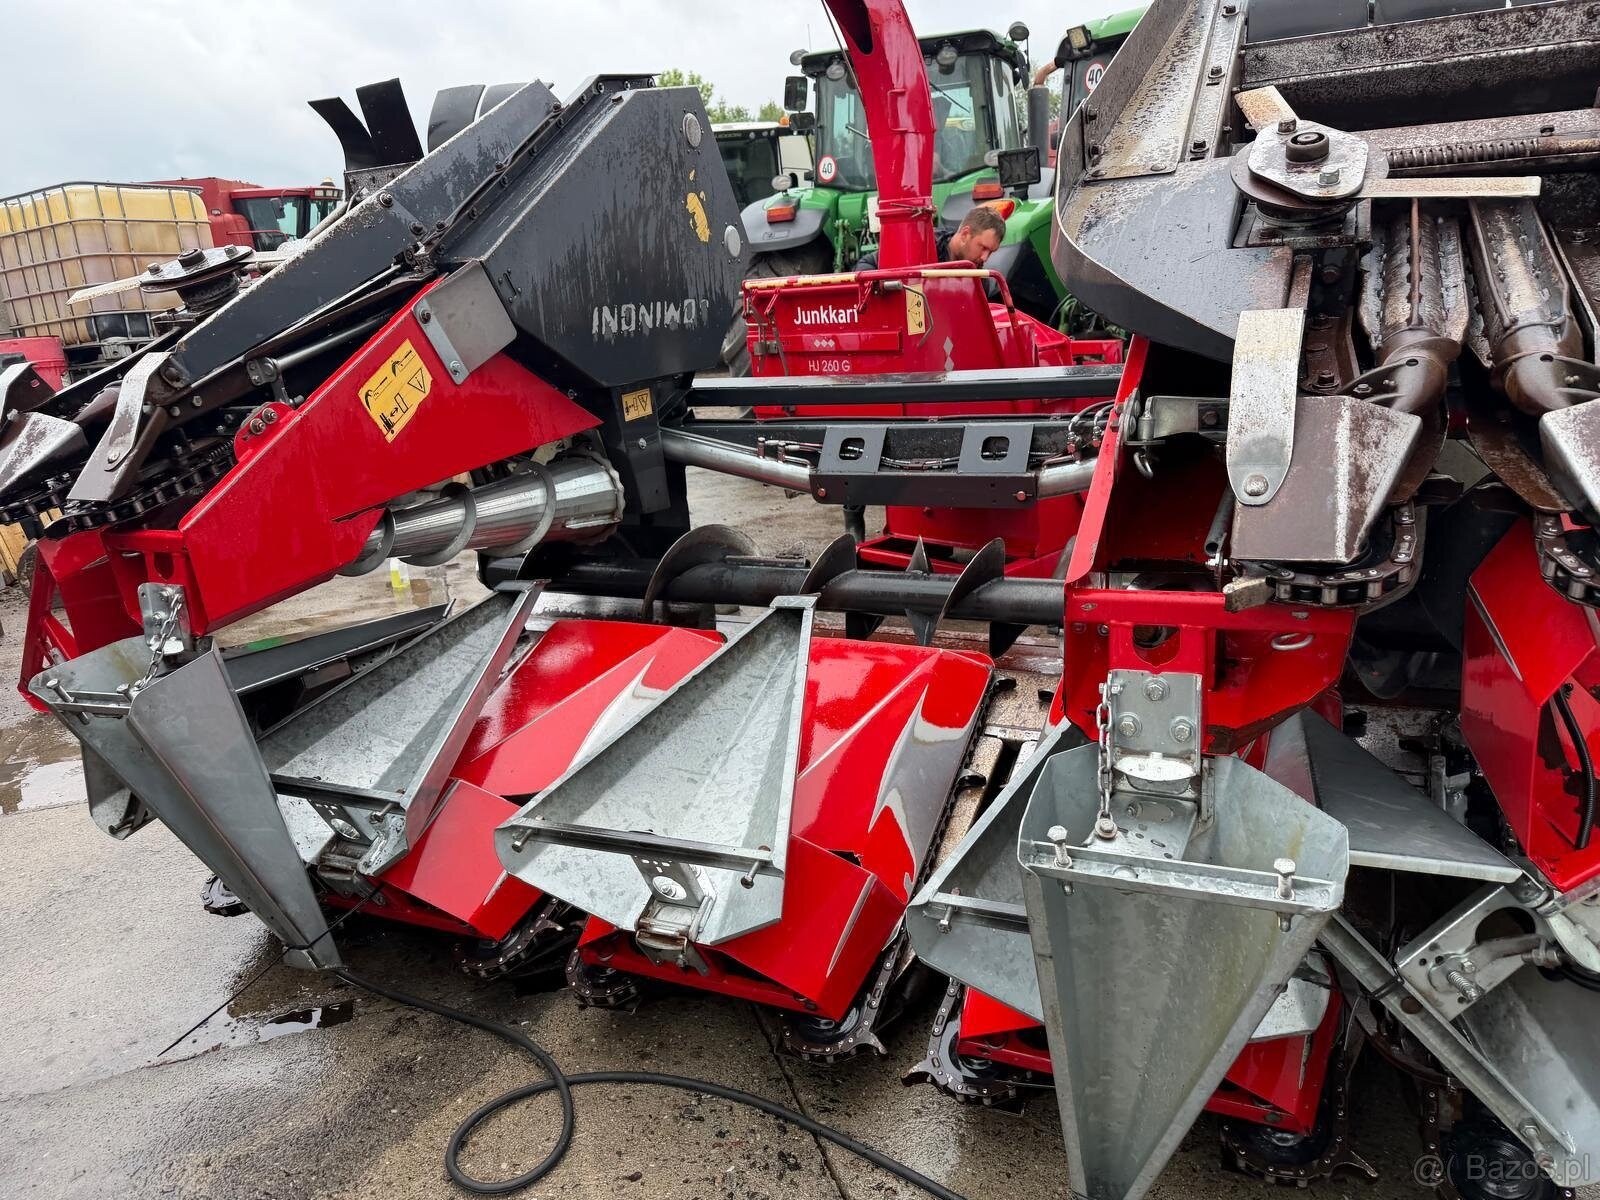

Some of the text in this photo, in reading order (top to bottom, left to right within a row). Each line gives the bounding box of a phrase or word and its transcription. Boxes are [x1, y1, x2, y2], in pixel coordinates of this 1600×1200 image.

[1088, 69, 1103, 85] 40
[822, 162, 832, 174] 40
[793, 304, 859, 325] Junkkari
[808, 359, 851, 372] HJ 260 G
